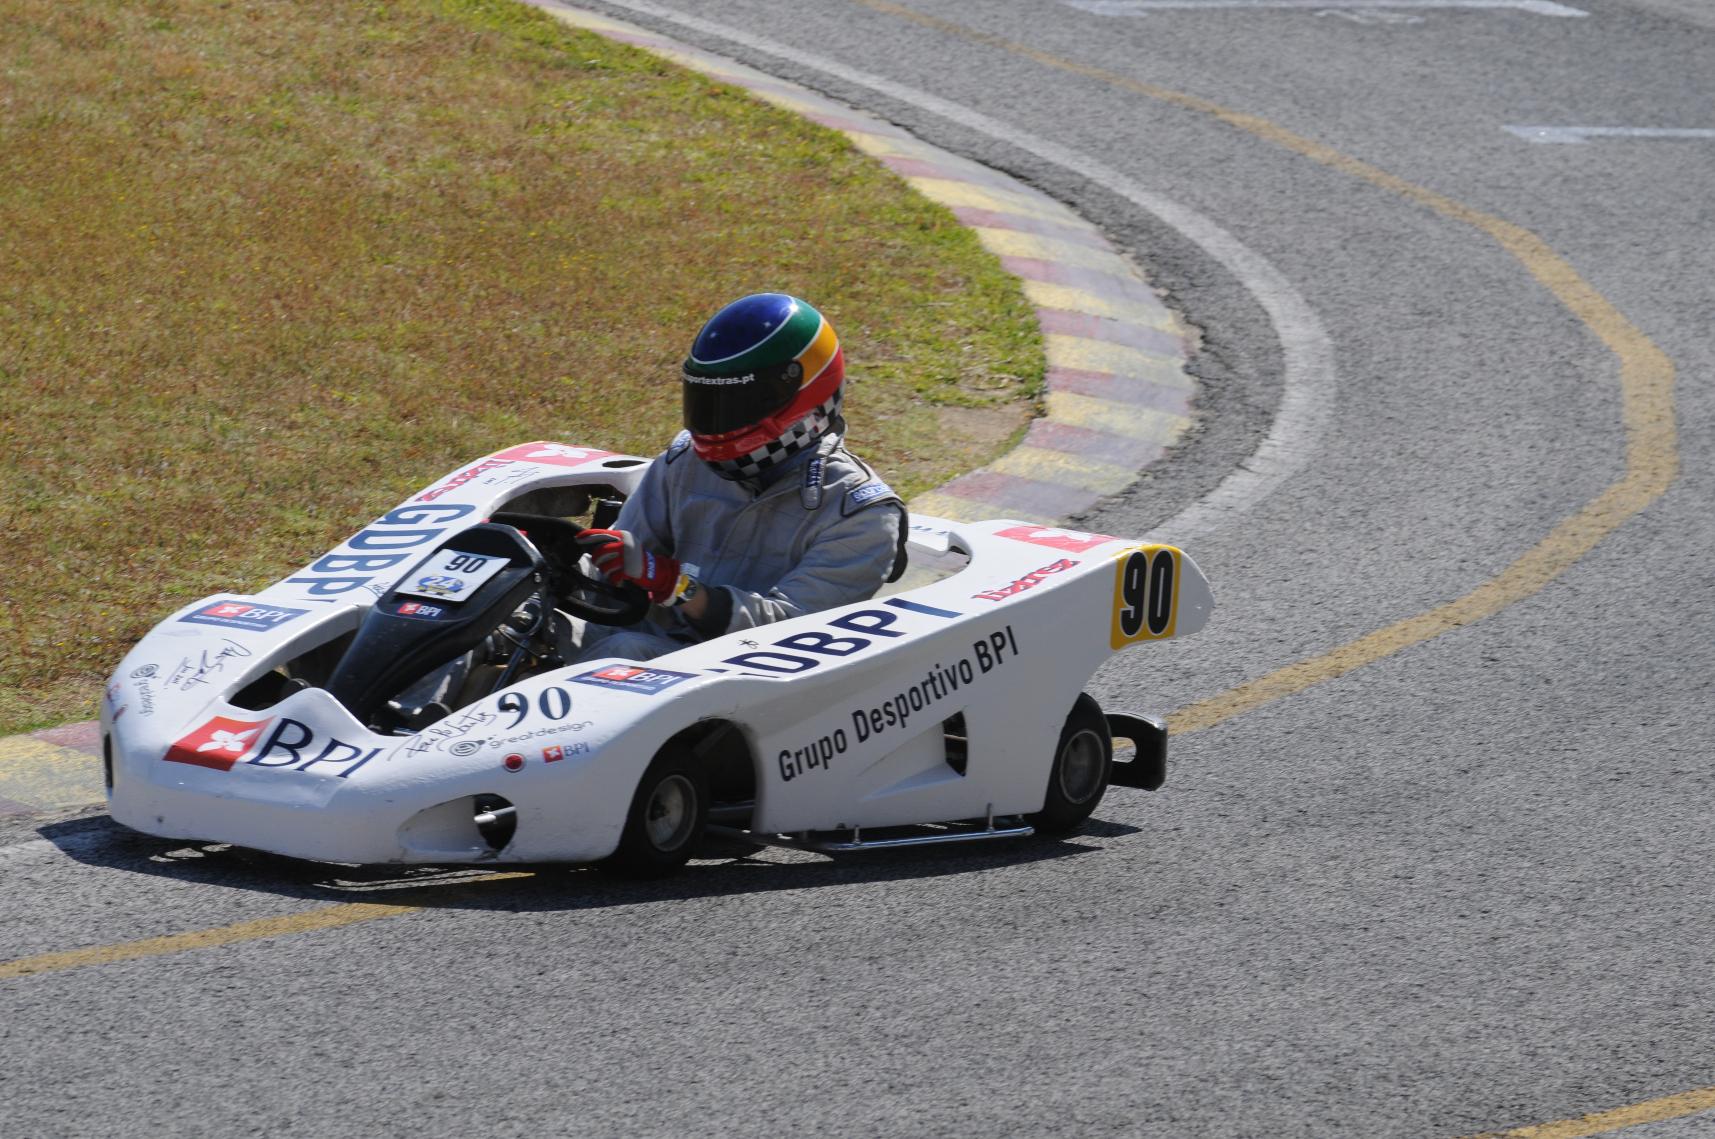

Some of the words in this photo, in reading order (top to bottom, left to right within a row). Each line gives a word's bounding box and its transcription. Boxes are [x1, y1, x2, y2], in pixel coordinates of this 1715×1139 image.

[444, 554, 487, 574] 90
[1120, 550, 1174, 636] 90
[240, 608, 293, 623] BPI
[416, 605, 442, 617] BPI
[703, 597, 963, 678] DBPI
[633, 672, 681, 687] BPI
[497, 686, 572, 729] 90
[778, 727, 848, 782] Grupo
[851, 657, 974, 743] Desportivo
[973, 624, 1019, 674] BPI
[246, 718, 386, 778] BPI
[489, 720, 594, 749] greatdesign
[563, 741, 590, 757] BPI
